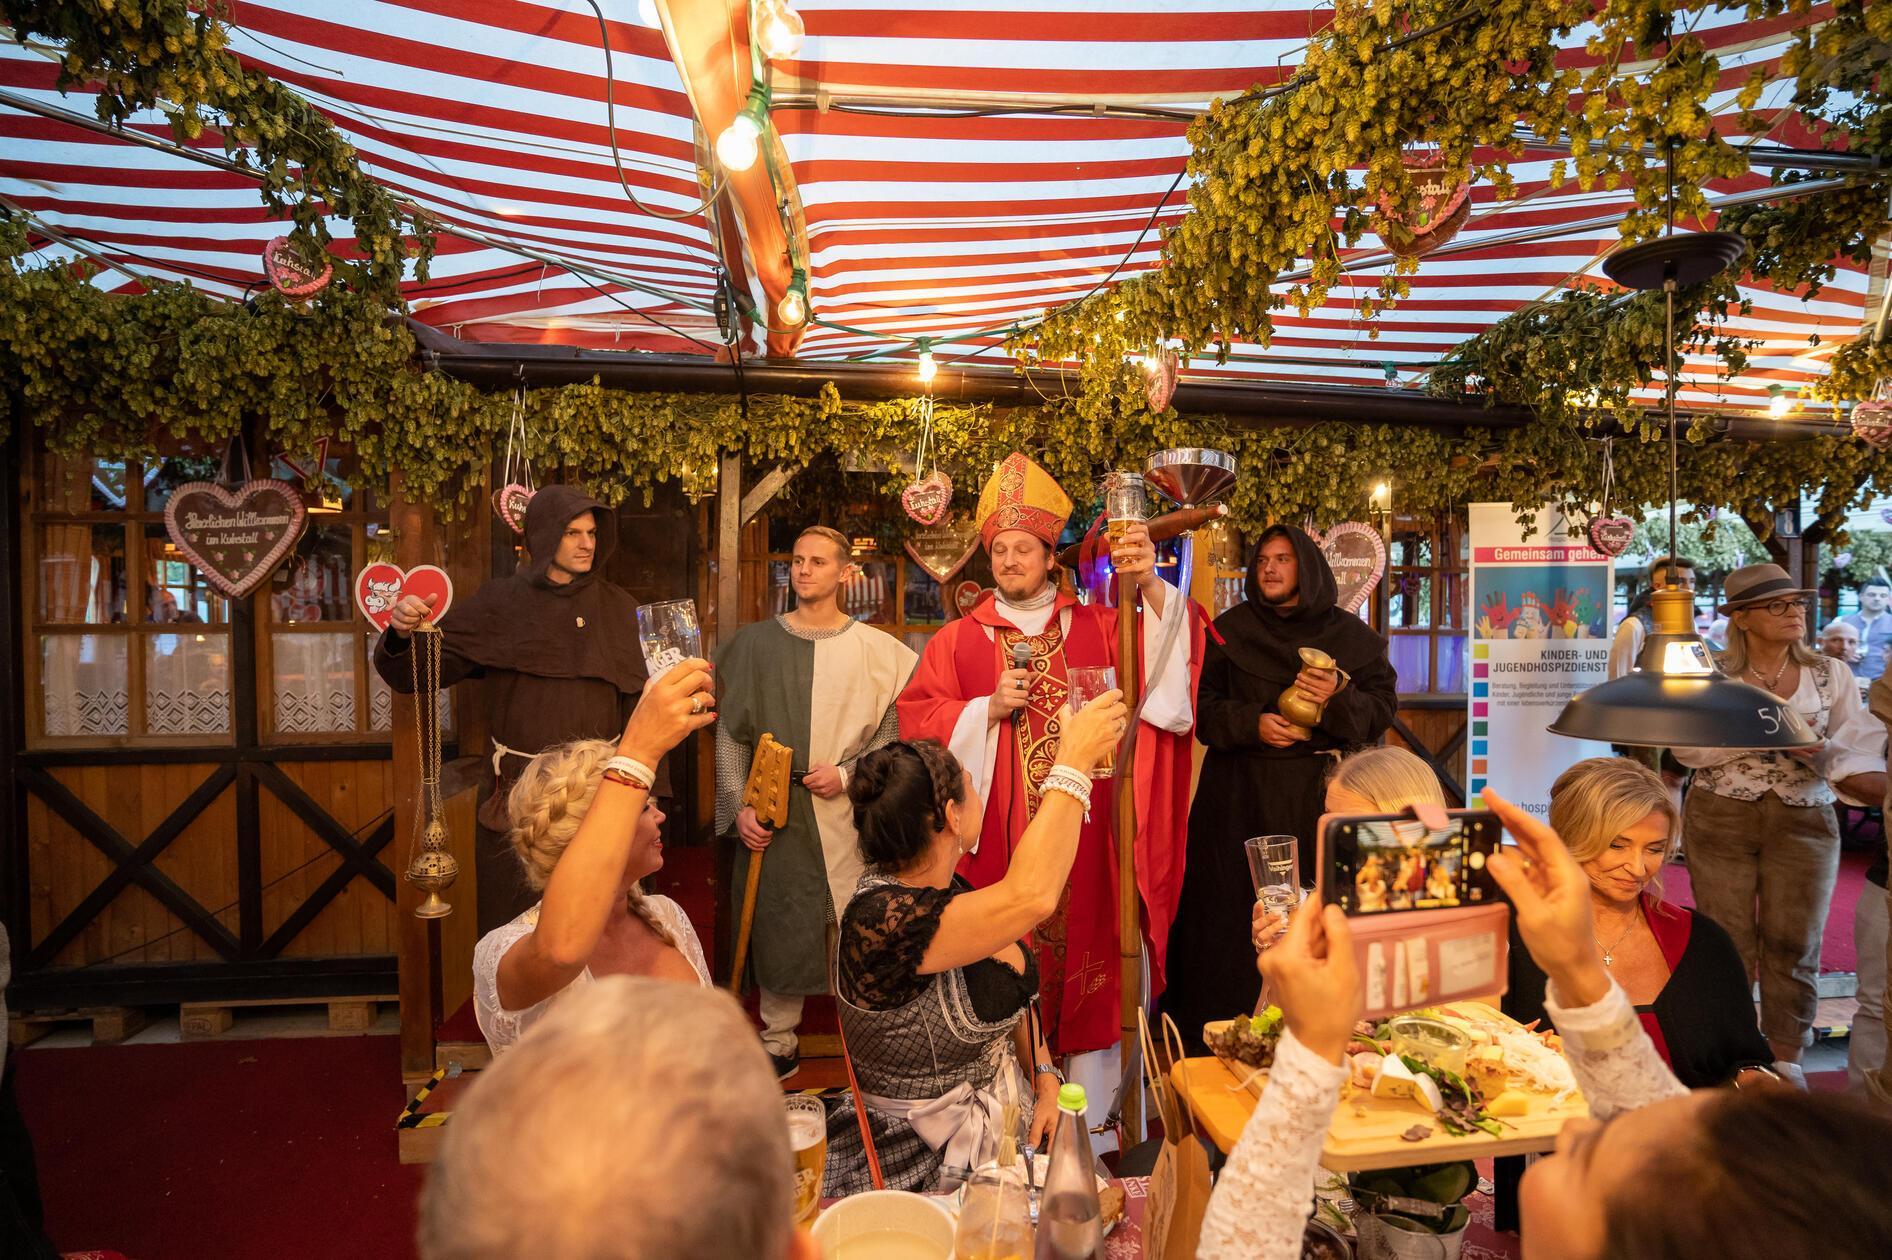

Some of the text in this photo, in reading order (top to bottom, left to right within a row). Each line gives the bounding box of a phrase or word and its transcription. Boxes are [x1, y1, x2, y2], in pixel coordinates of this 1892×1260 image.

[205, 532, 258, 545] im Kuhstall
[1494, 548, 1565, 561] Gemeinsam
[1541, 650, 1608, 660] KINDER- UND
[1493, 662, 1608, 673] JUGENDHOSPIZDIENST
